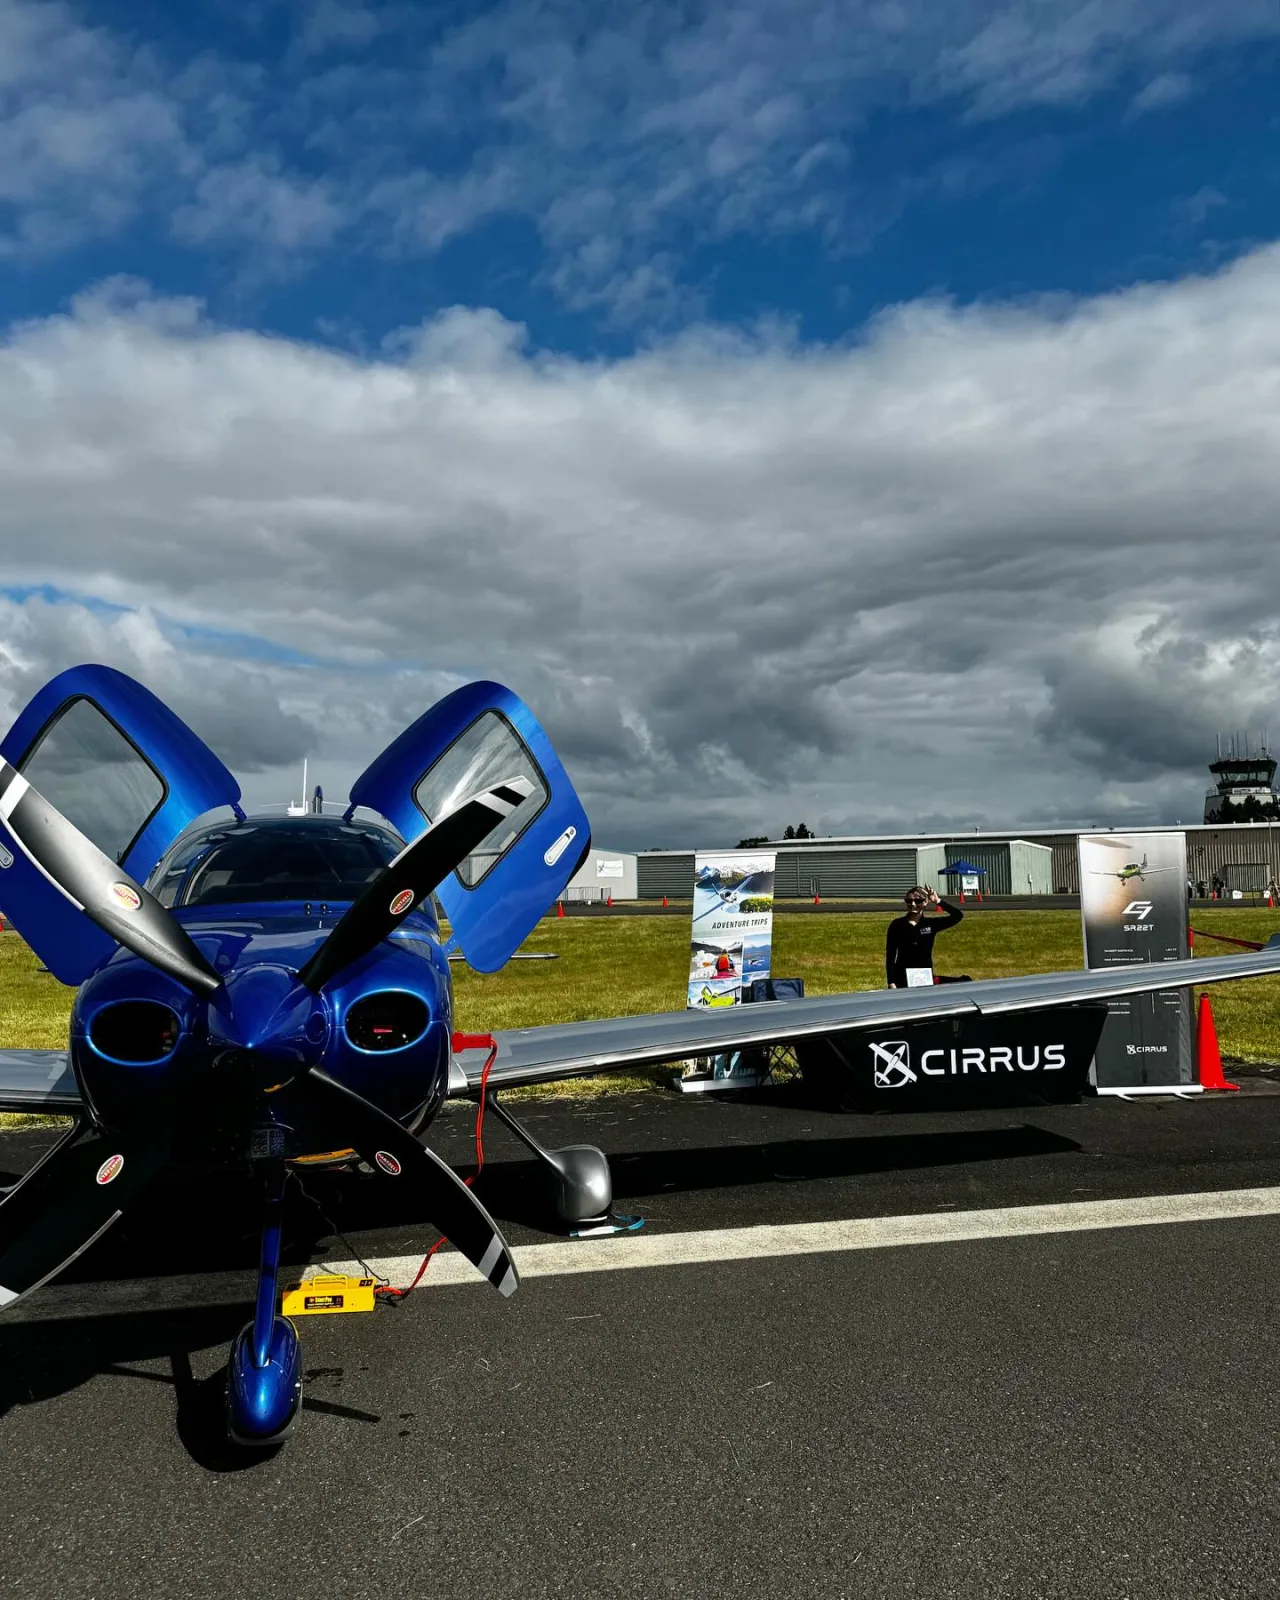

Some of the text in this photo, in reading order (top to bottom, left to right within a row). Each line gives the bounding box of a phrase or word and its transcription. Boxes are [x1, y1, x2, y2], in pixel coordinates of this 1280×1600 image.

[712, 917, 768, 930] ADVENTURE TRIPS
[1123, 924, 1154, 932] SR22T
[921, 1044, 1065, 1075] CIRRUS
